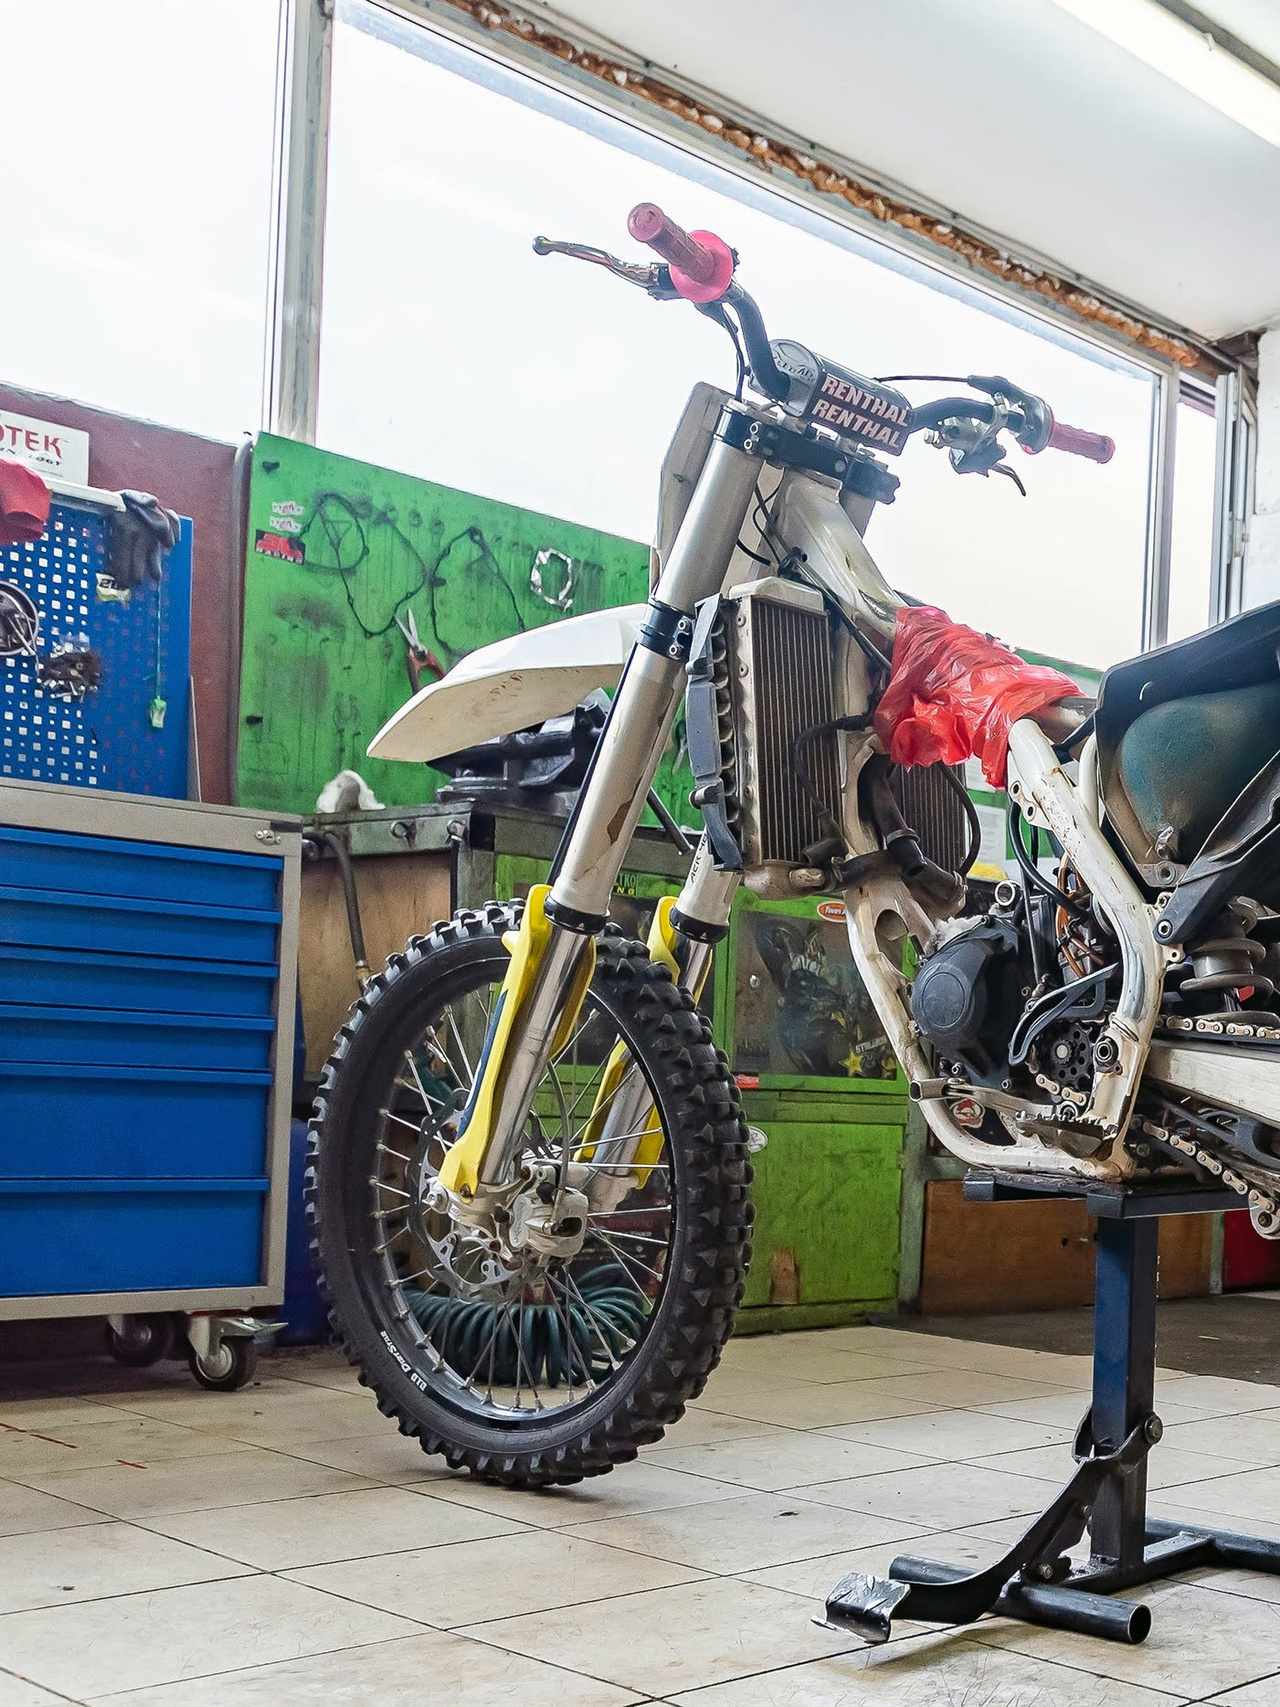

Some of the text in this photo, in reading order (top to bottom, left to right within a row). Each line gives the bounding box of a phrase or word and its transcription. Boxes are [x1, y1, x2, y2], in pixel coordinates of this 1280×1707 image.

[811, 398, 903, 448] RENTHAL
[821, 375, 909, 427] RENTHAL
[0, 424, 62, 459] TEK
